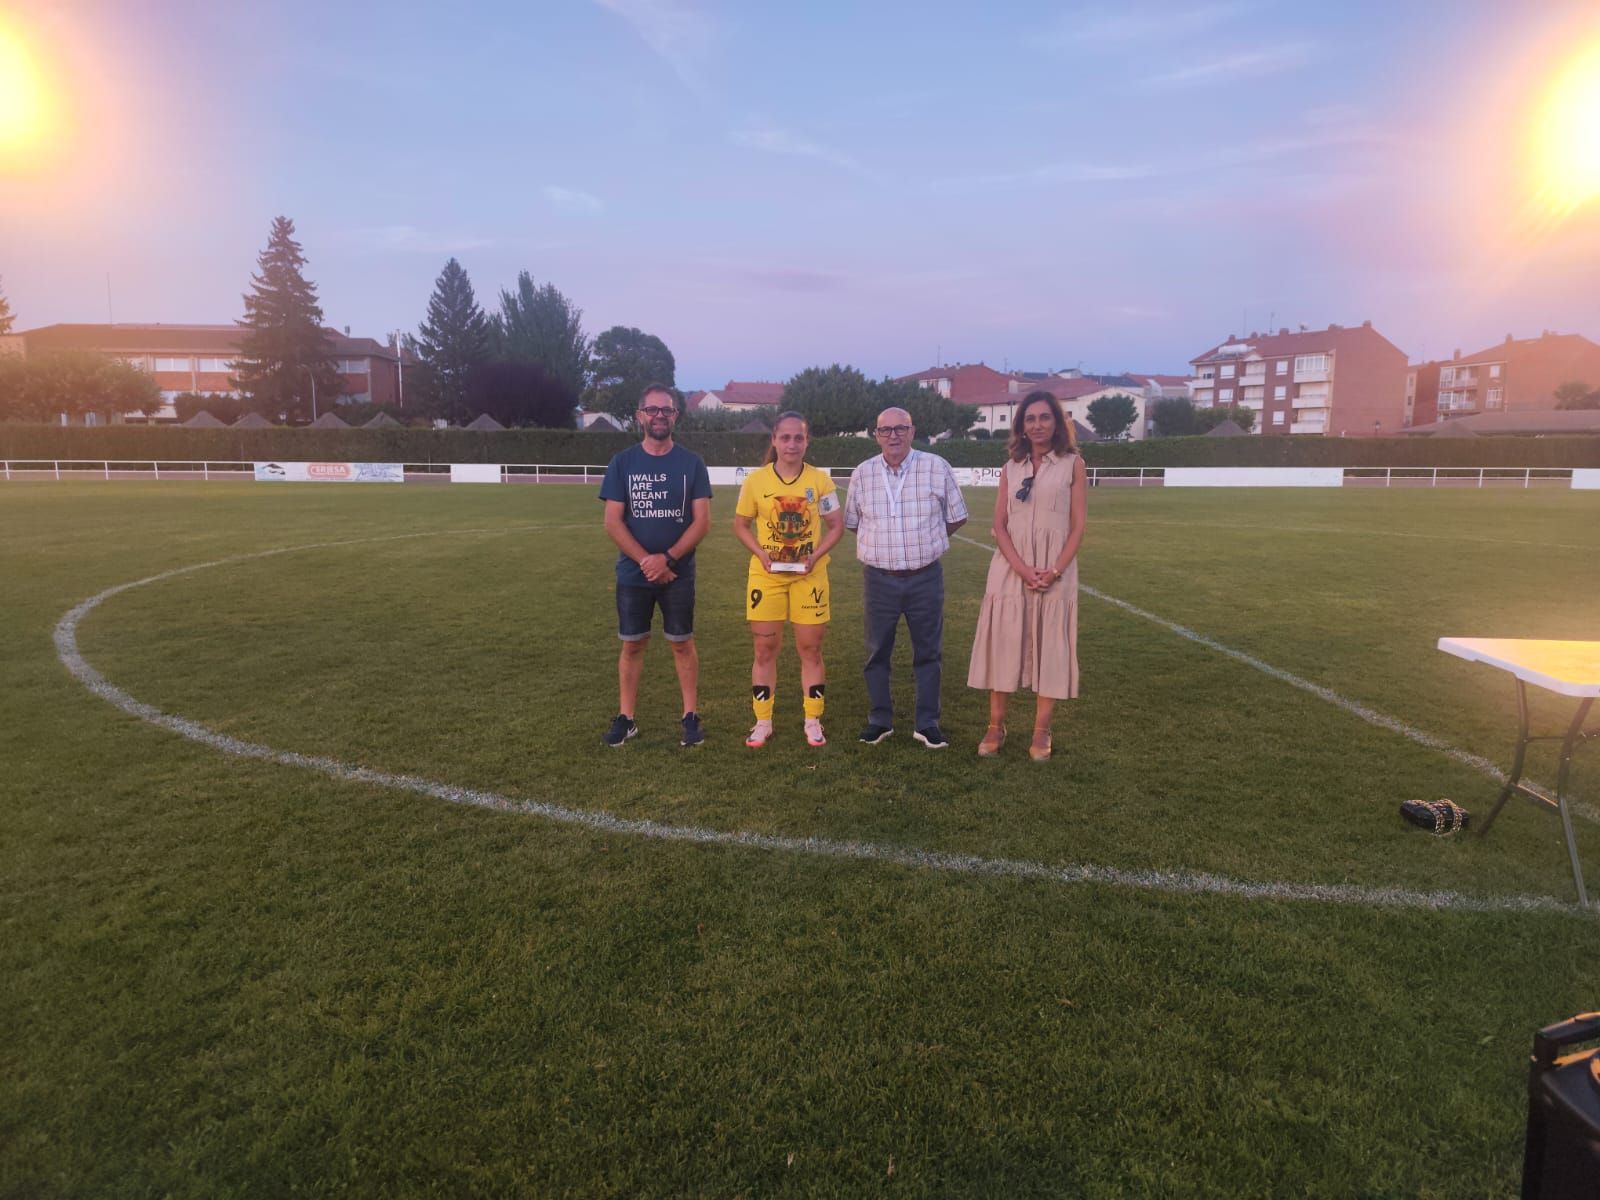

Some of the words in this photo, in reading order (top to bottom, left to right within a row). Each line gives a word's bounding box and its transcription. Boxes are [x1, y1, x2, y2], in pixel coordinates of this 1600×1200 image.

[632, 474, 667, 482] WALLS
[632, 482, 653, 491] ARE
[632, 491, 668, 500] MEANT
[633, 500, 653, 509] FOR
[633, 509, 681, 518] CLIMBING
[750, 589, 763, 609] 9
